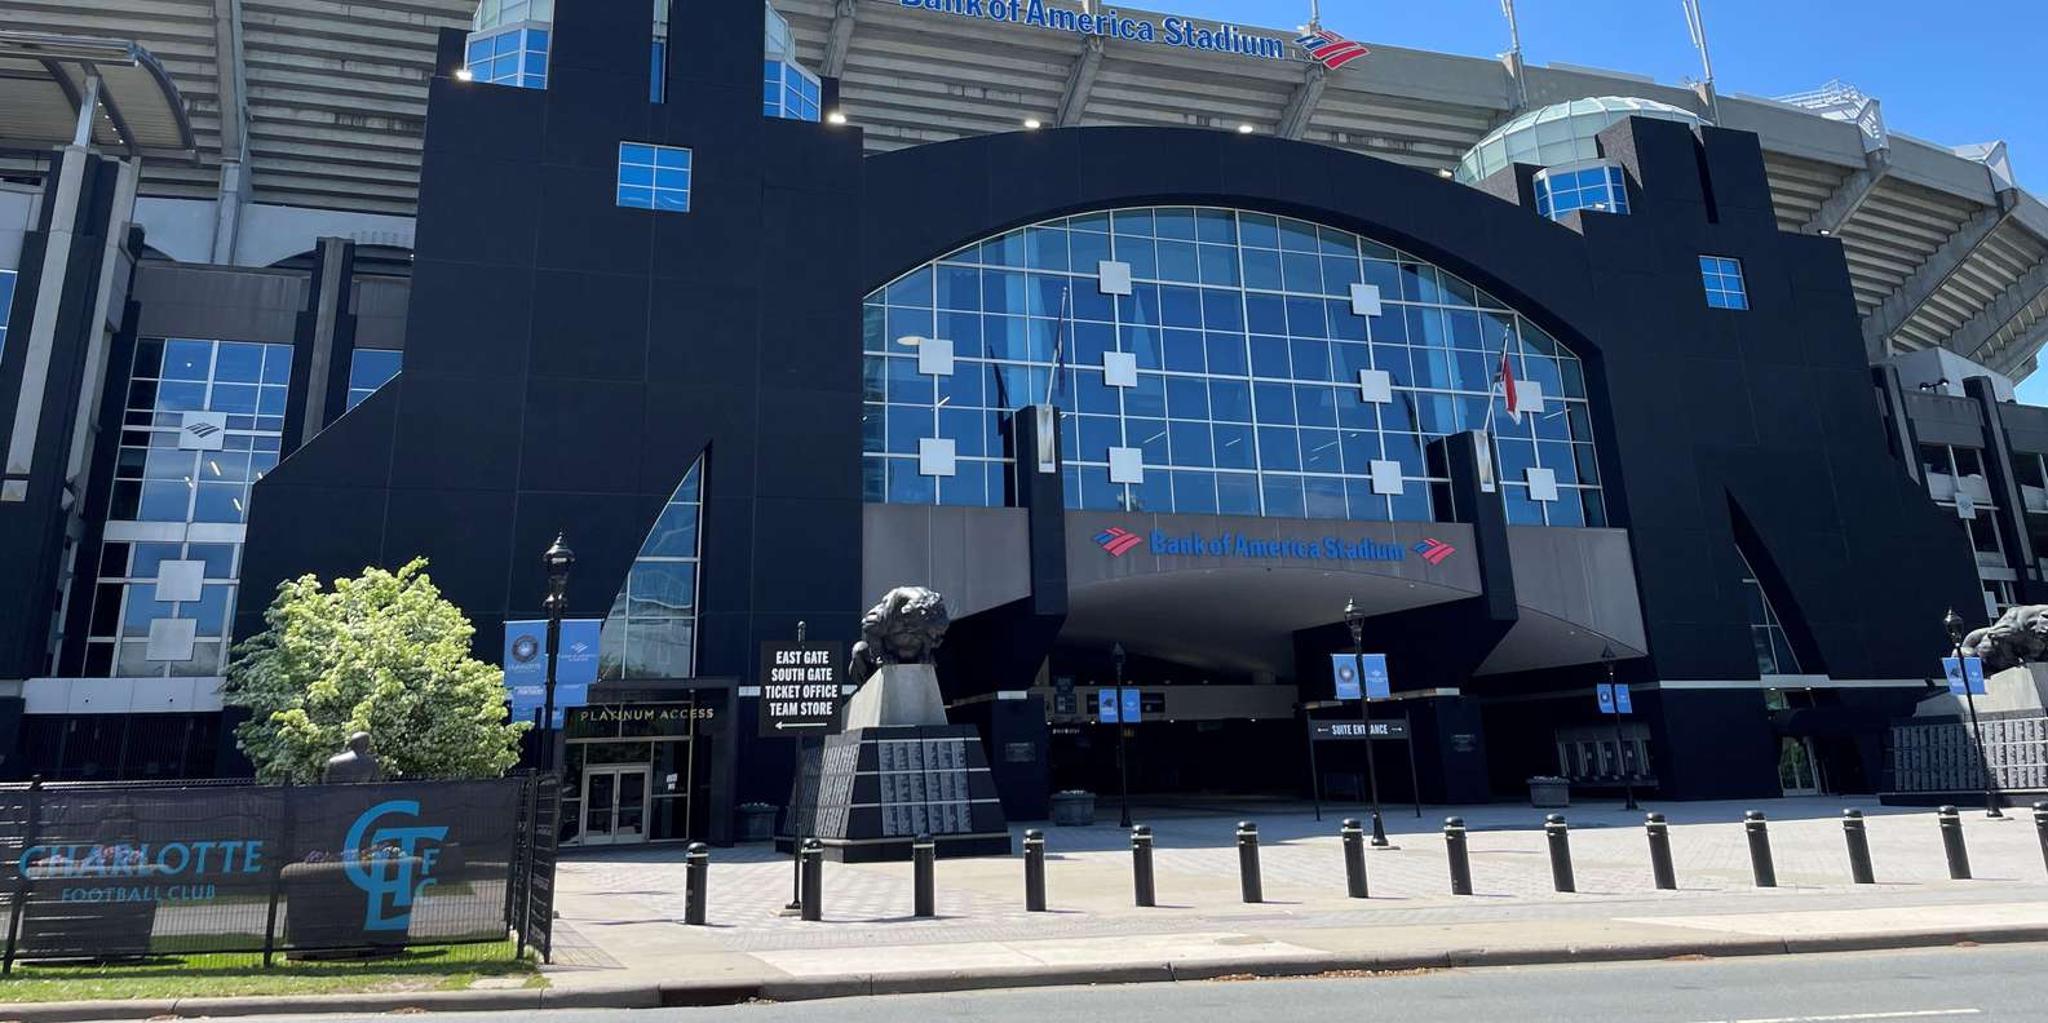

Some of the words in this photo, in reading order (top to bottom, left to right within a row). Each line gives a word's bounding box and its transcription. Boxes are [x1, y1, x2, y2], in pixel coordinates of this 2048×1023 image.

[900, 0, 984, 17] ank
[988, 0, 1021, 22] of
[1024, 0, 1154, 41] America
[1163, 16, 1284, 60] Stadium
[1149, 528, 1205, 556] Bank
[1207, 531, 1232, 557] of
[1234, 532, 1320, 559] America
[1322, 535, 1406, 561] Stadium
[776, 651, 801, 664] EAST
[804, 651, 829, 664] GATE
[771, 668, 804, 681] SOUTH
[807, 668, 833, 681] GATE
[765, 685, 800, 699] TICKET
[803, 684, 838, 698] OFFICE
[580, 709, 655, 721] PLATINUM
[660, 708, 714, 720] ACCESS
[769, 702, 798, 716] TEAM
[800, 701, 833, 715] STORE
[1332, 724, 1352, 735] SUITE
[1353, 724, 1388, 735] ENTANCE
[18, 841, 263, 881] CHARLOTTE
[61, 885, 161, 903] FOOTBALL
[167, 884, 216, 900] CLUB
